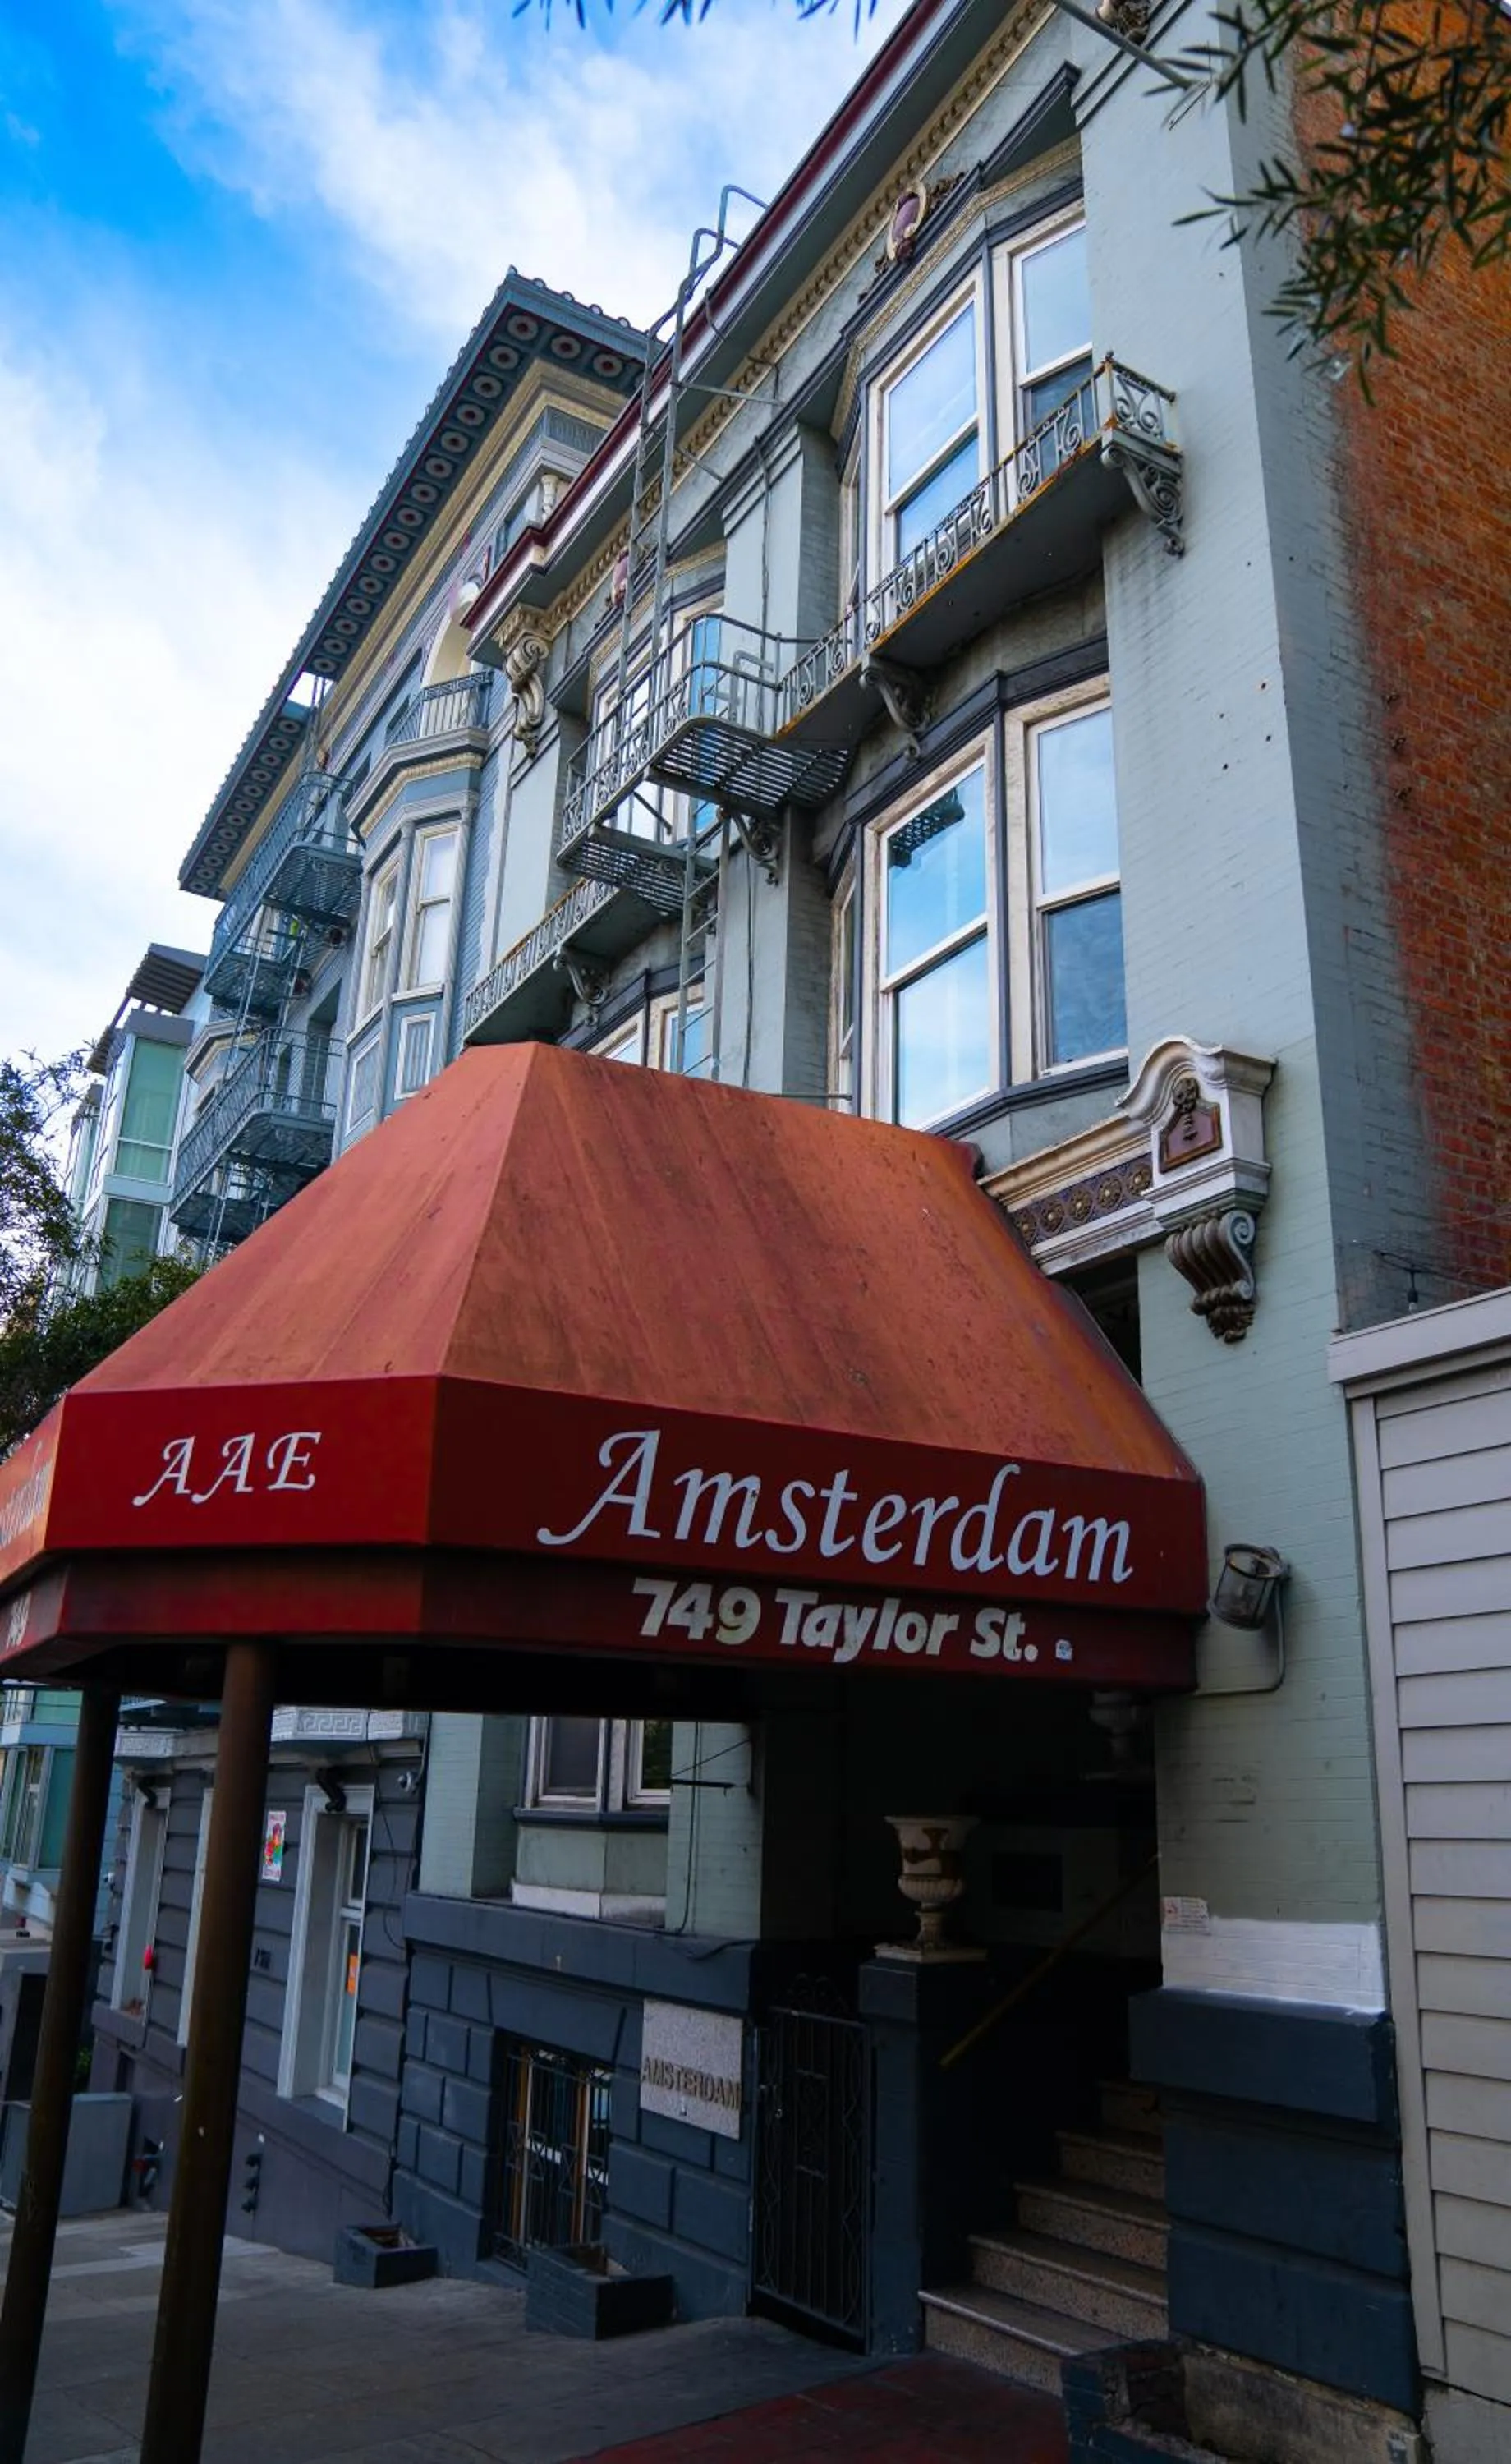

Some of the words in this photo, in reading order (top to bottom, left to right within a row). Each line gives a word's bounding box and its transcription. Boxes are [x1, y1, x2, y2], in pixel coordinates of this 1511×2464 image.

[536, 1429, 1133, 1583] Amsterdam
[632, 1578, 761, 1645] 749
[774, 1588, 960, 1663] Taylor
[969, 1607, 1039, 1662] St.
[641, 2056, 742, 2111] AMSTERDAM
